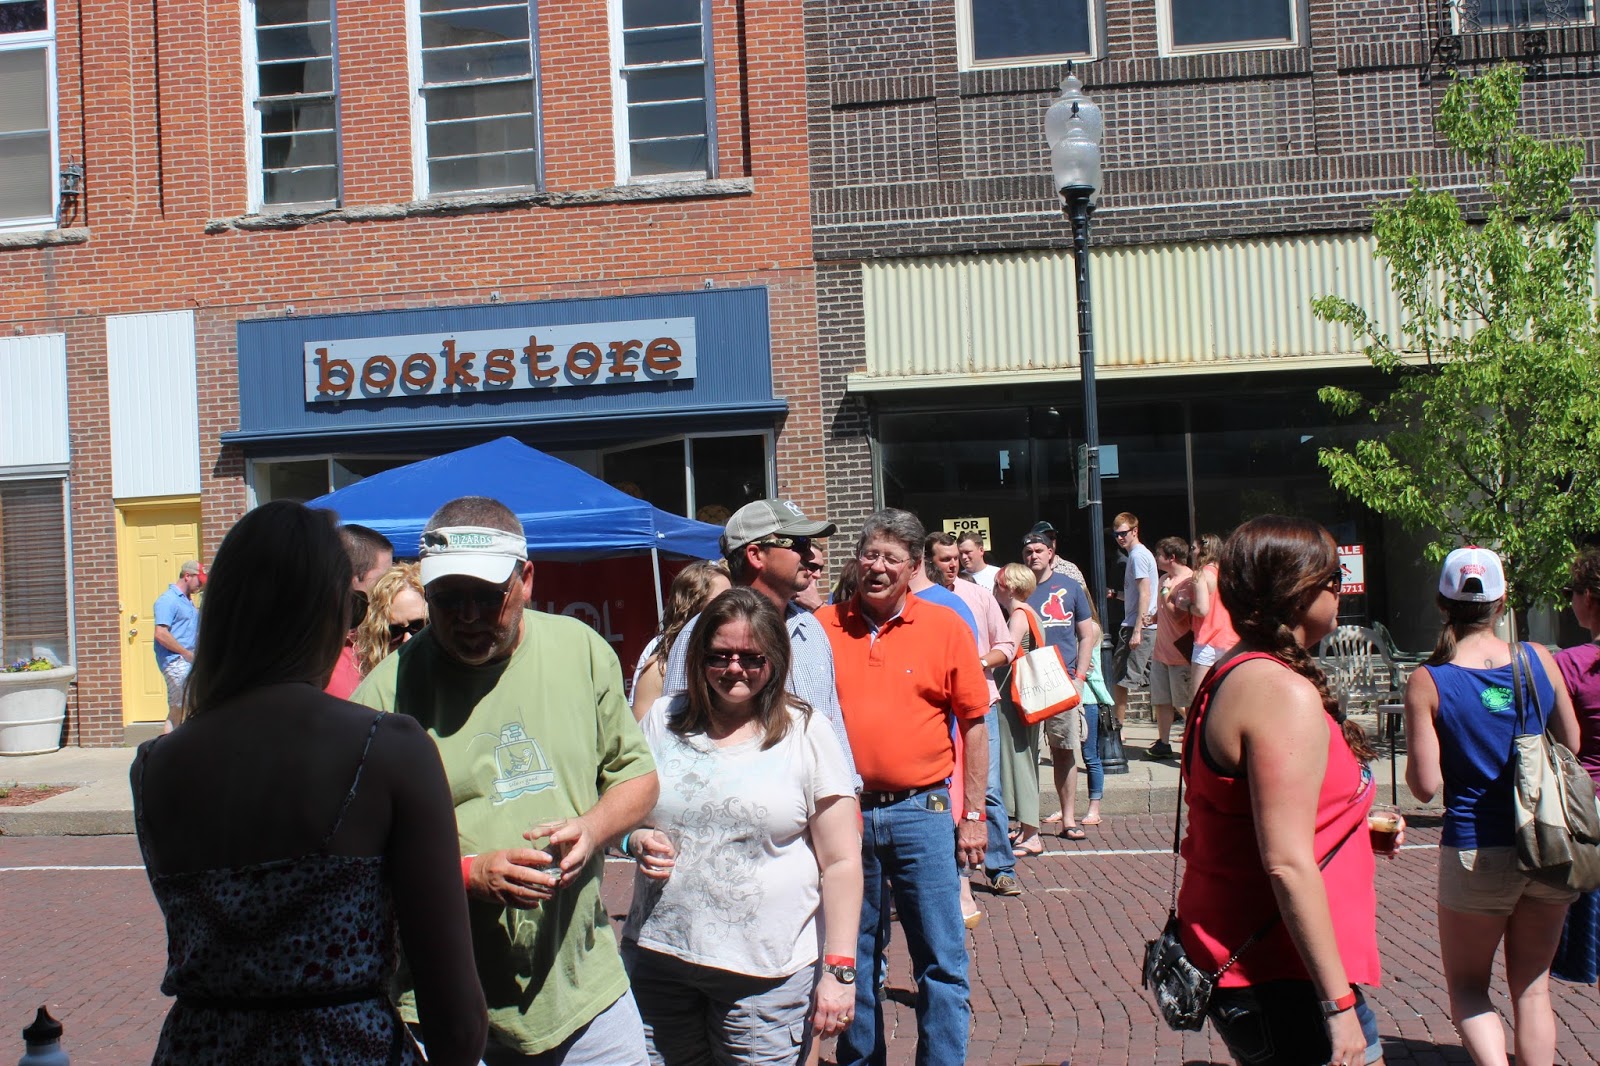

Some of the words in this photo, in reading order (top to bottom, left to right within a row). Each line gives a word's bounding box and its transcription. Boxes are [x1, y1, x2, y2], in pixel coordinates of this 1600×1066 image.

[315, 335, 682, 393] bookstore
[953, 520, 979, 530] FOR
[450, 534, 492, 545] LIZARDS
[947, 529, 988, 541] SE
[1337, 545, 1361, 555] ALE
